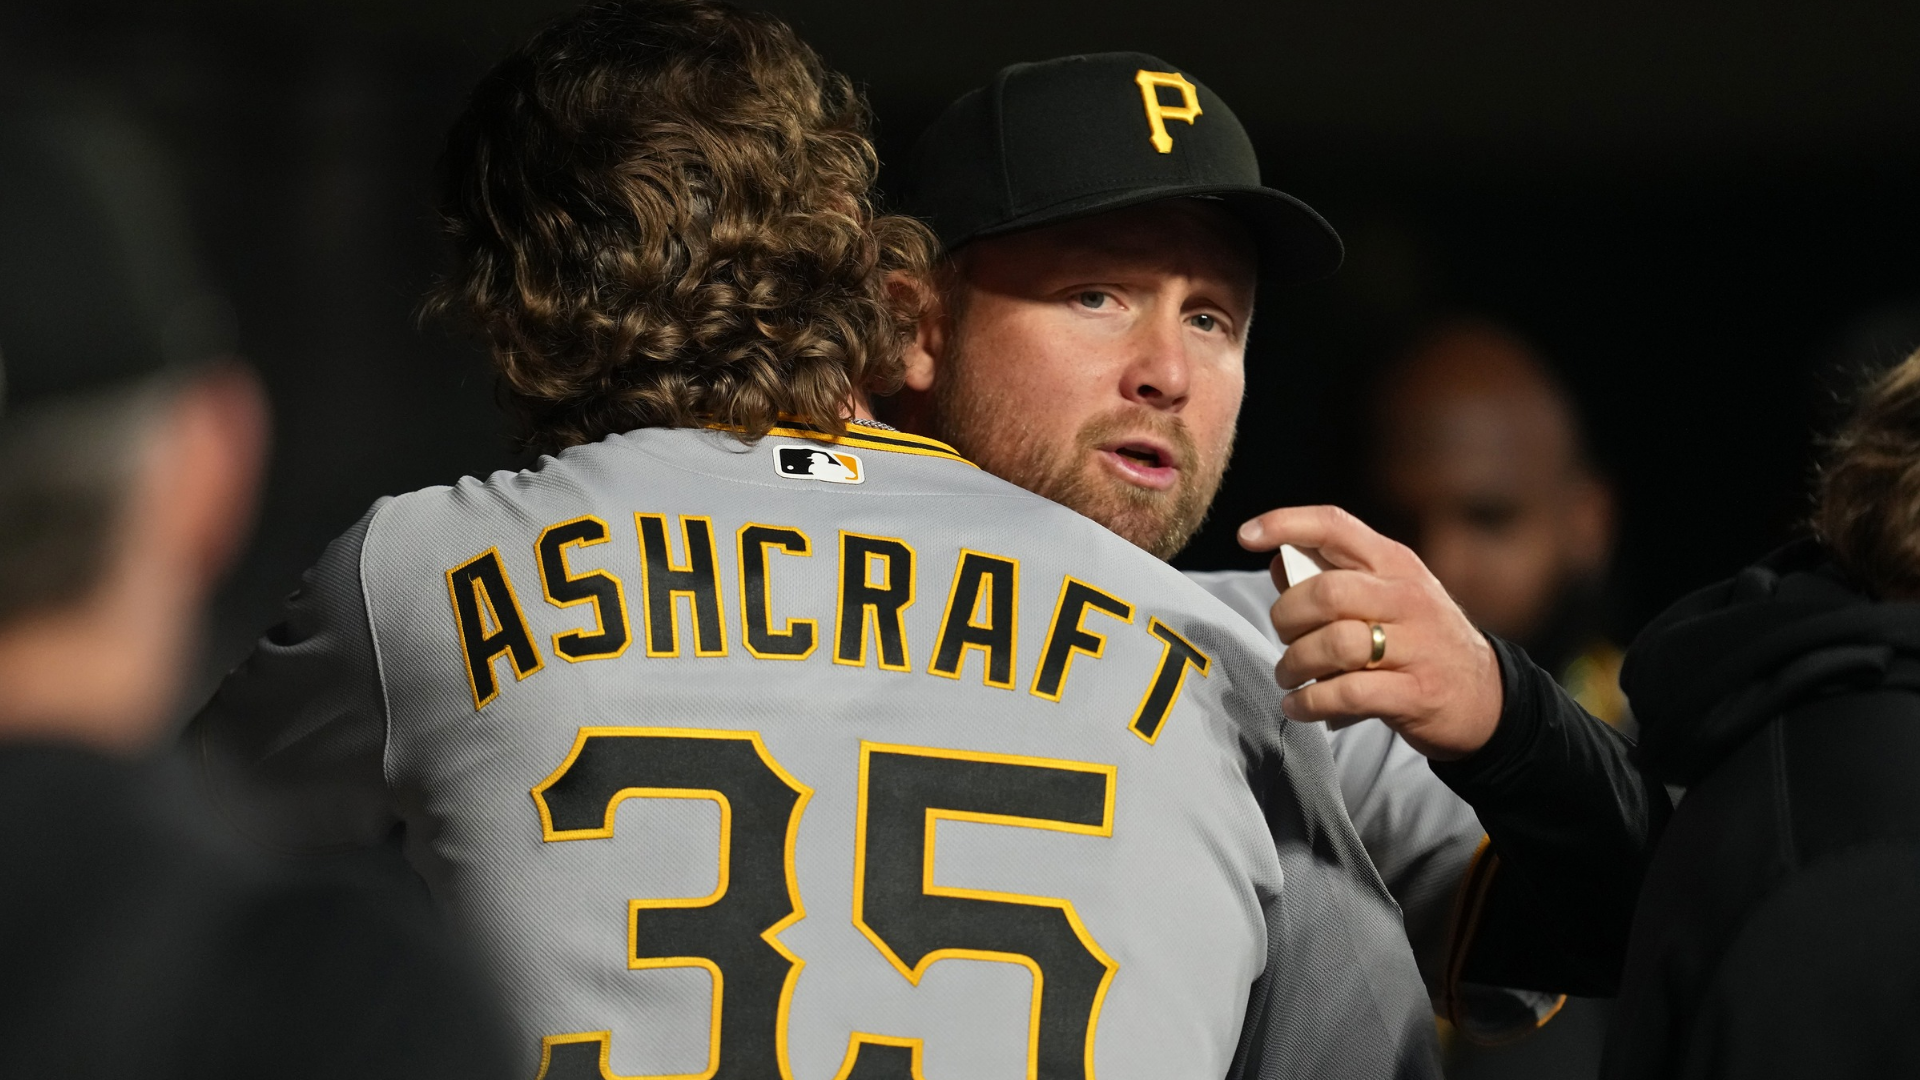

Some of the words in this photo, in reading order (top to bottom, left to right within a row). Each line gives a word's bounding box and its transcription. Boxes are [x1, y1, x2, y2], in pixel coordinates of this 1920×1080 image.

[1134, 69, 1204, 154] P
[445, 511, 1212, 745] ASHCRAFT
[530, 726, 1119, 1080] 35
